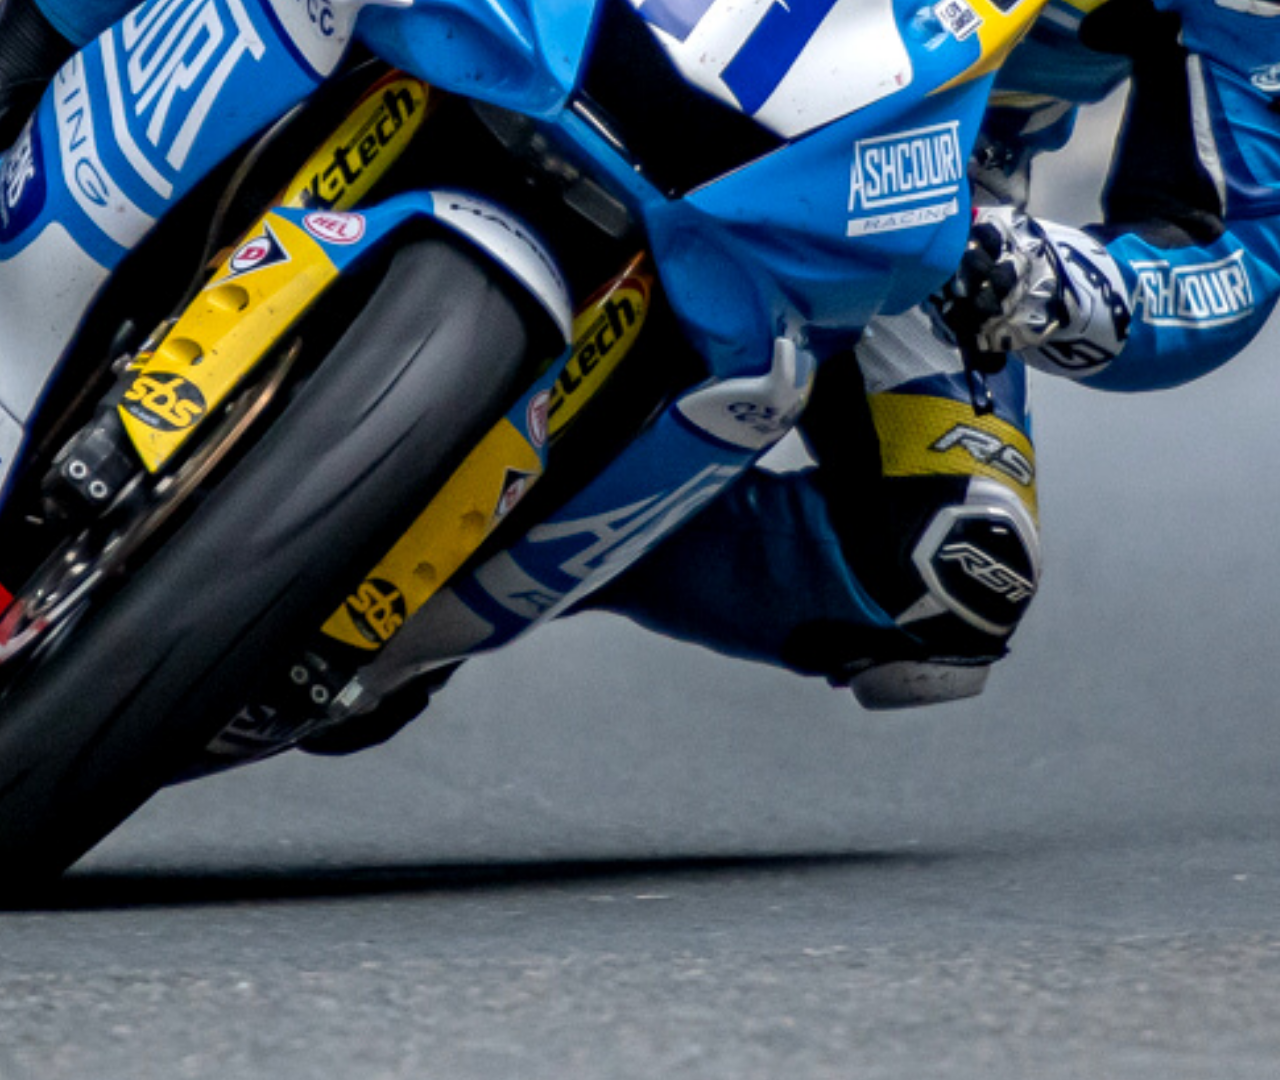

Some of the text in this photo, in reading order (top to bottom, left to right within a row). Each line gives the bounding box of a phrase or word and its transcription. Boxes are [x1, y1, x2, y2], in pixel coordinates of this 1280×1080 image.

[848, 120, 963, 212] ASHCOURT
[123, 376, 203, 428] sbs
[926, 424, 1036, 486] RS
[345, 582, 403, 641] sbs
